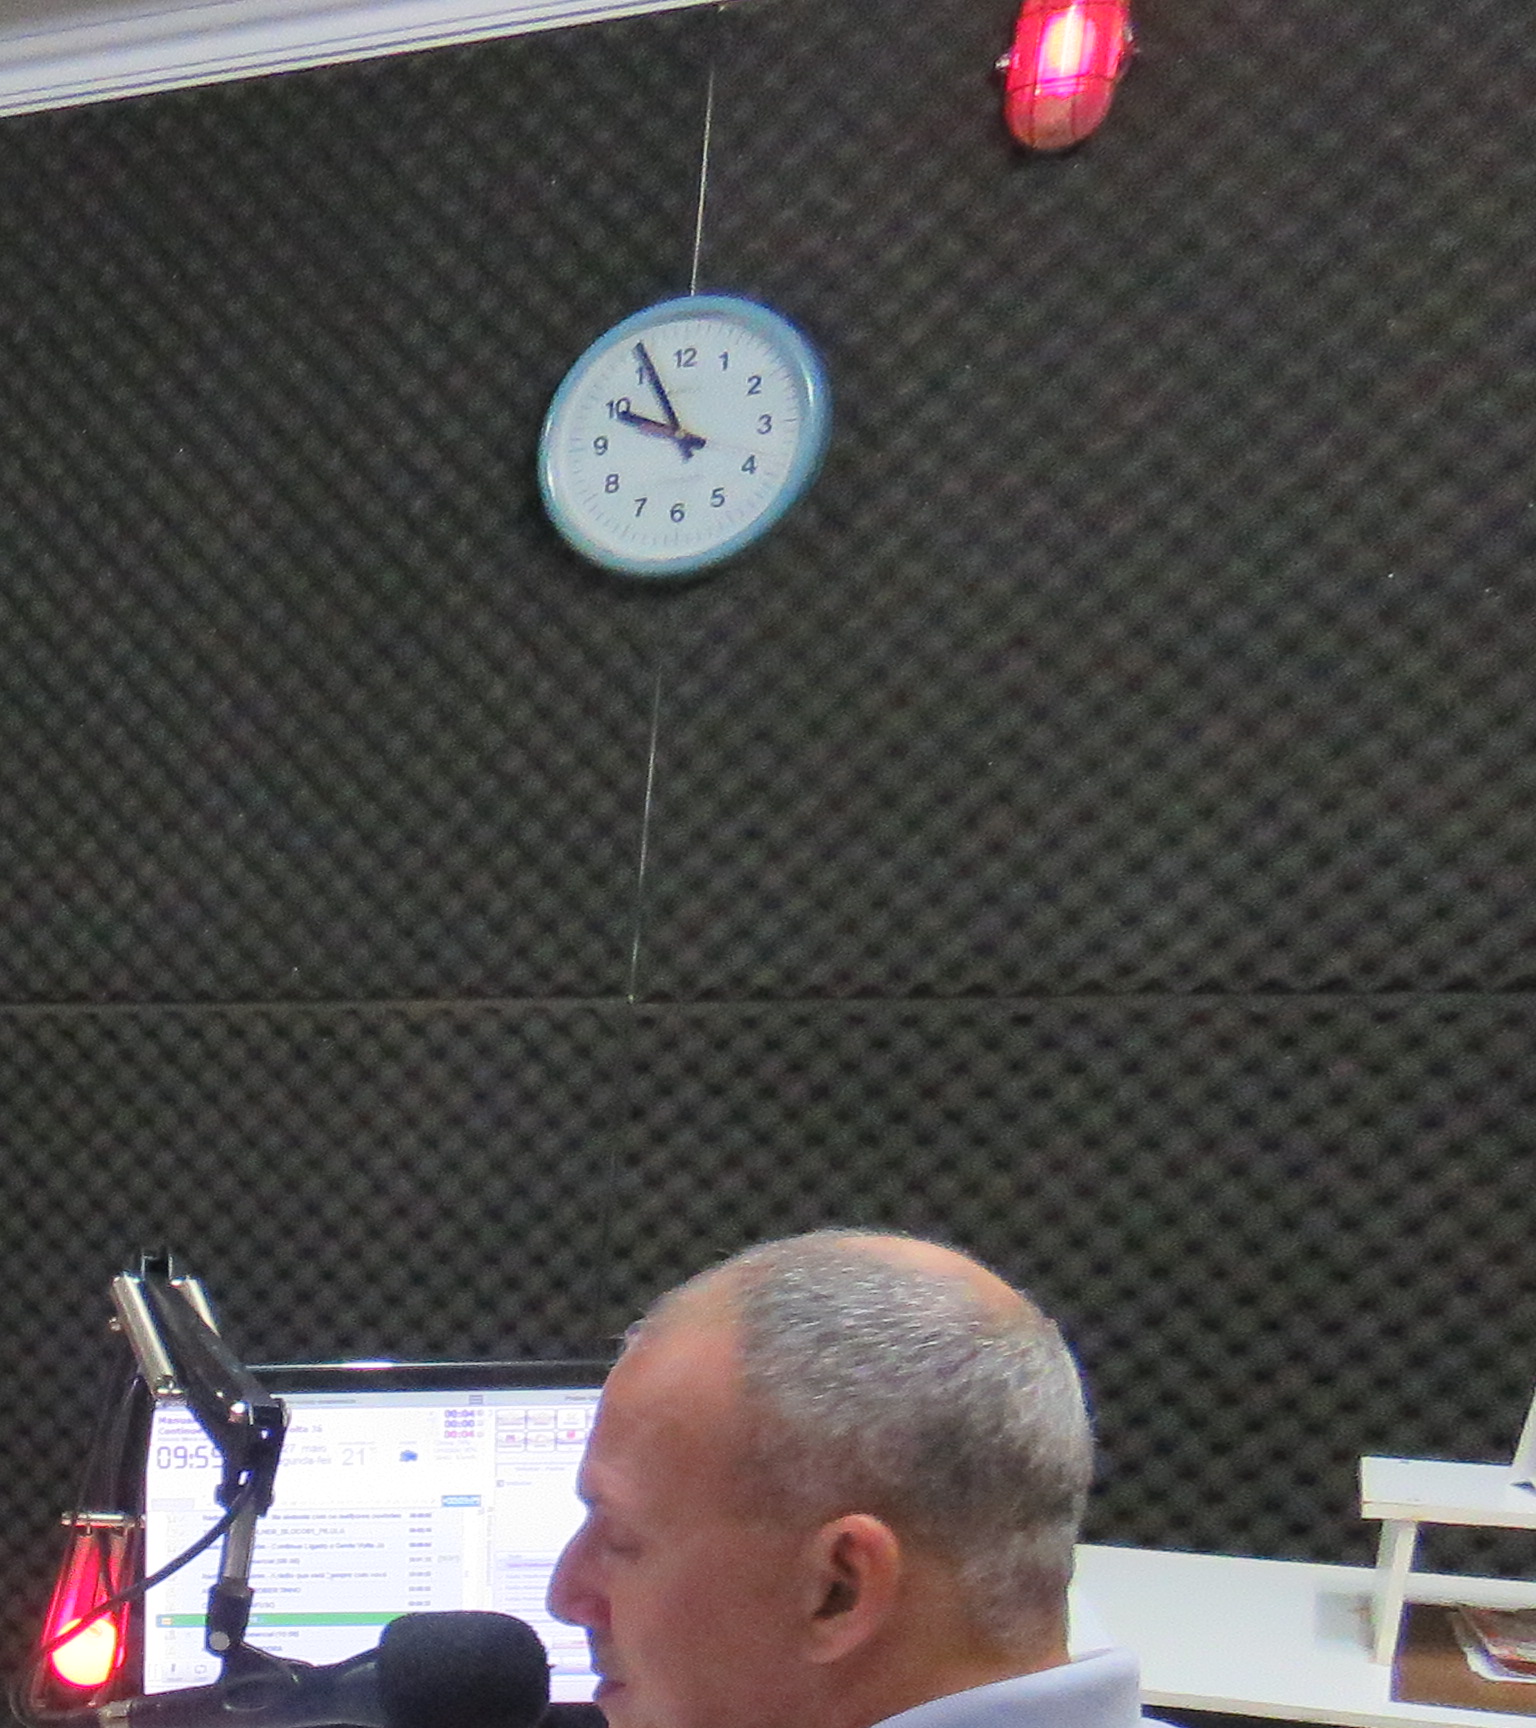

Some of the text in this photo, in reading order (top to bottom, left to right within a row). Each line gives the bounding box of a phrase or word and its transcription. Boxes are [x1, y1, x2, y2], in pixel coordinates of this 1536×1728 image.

[674, 347, 697, 369] 12
[719, 351, 729, 371] 1
[747, 376, 762, 395] 2
[607, 398, 631, 419] 10
[757, 414, 772, 435] 3
[593, 436, 608, 456] 9
[741, 455, 756, 475] 4
[604, 474, 619, 494] 8
[634, 498, 648, 517] 7
[711, 488, 726, 508] 5
[670, 503, 685, 523] 6
[341, 1448, 366, 1466] 21
